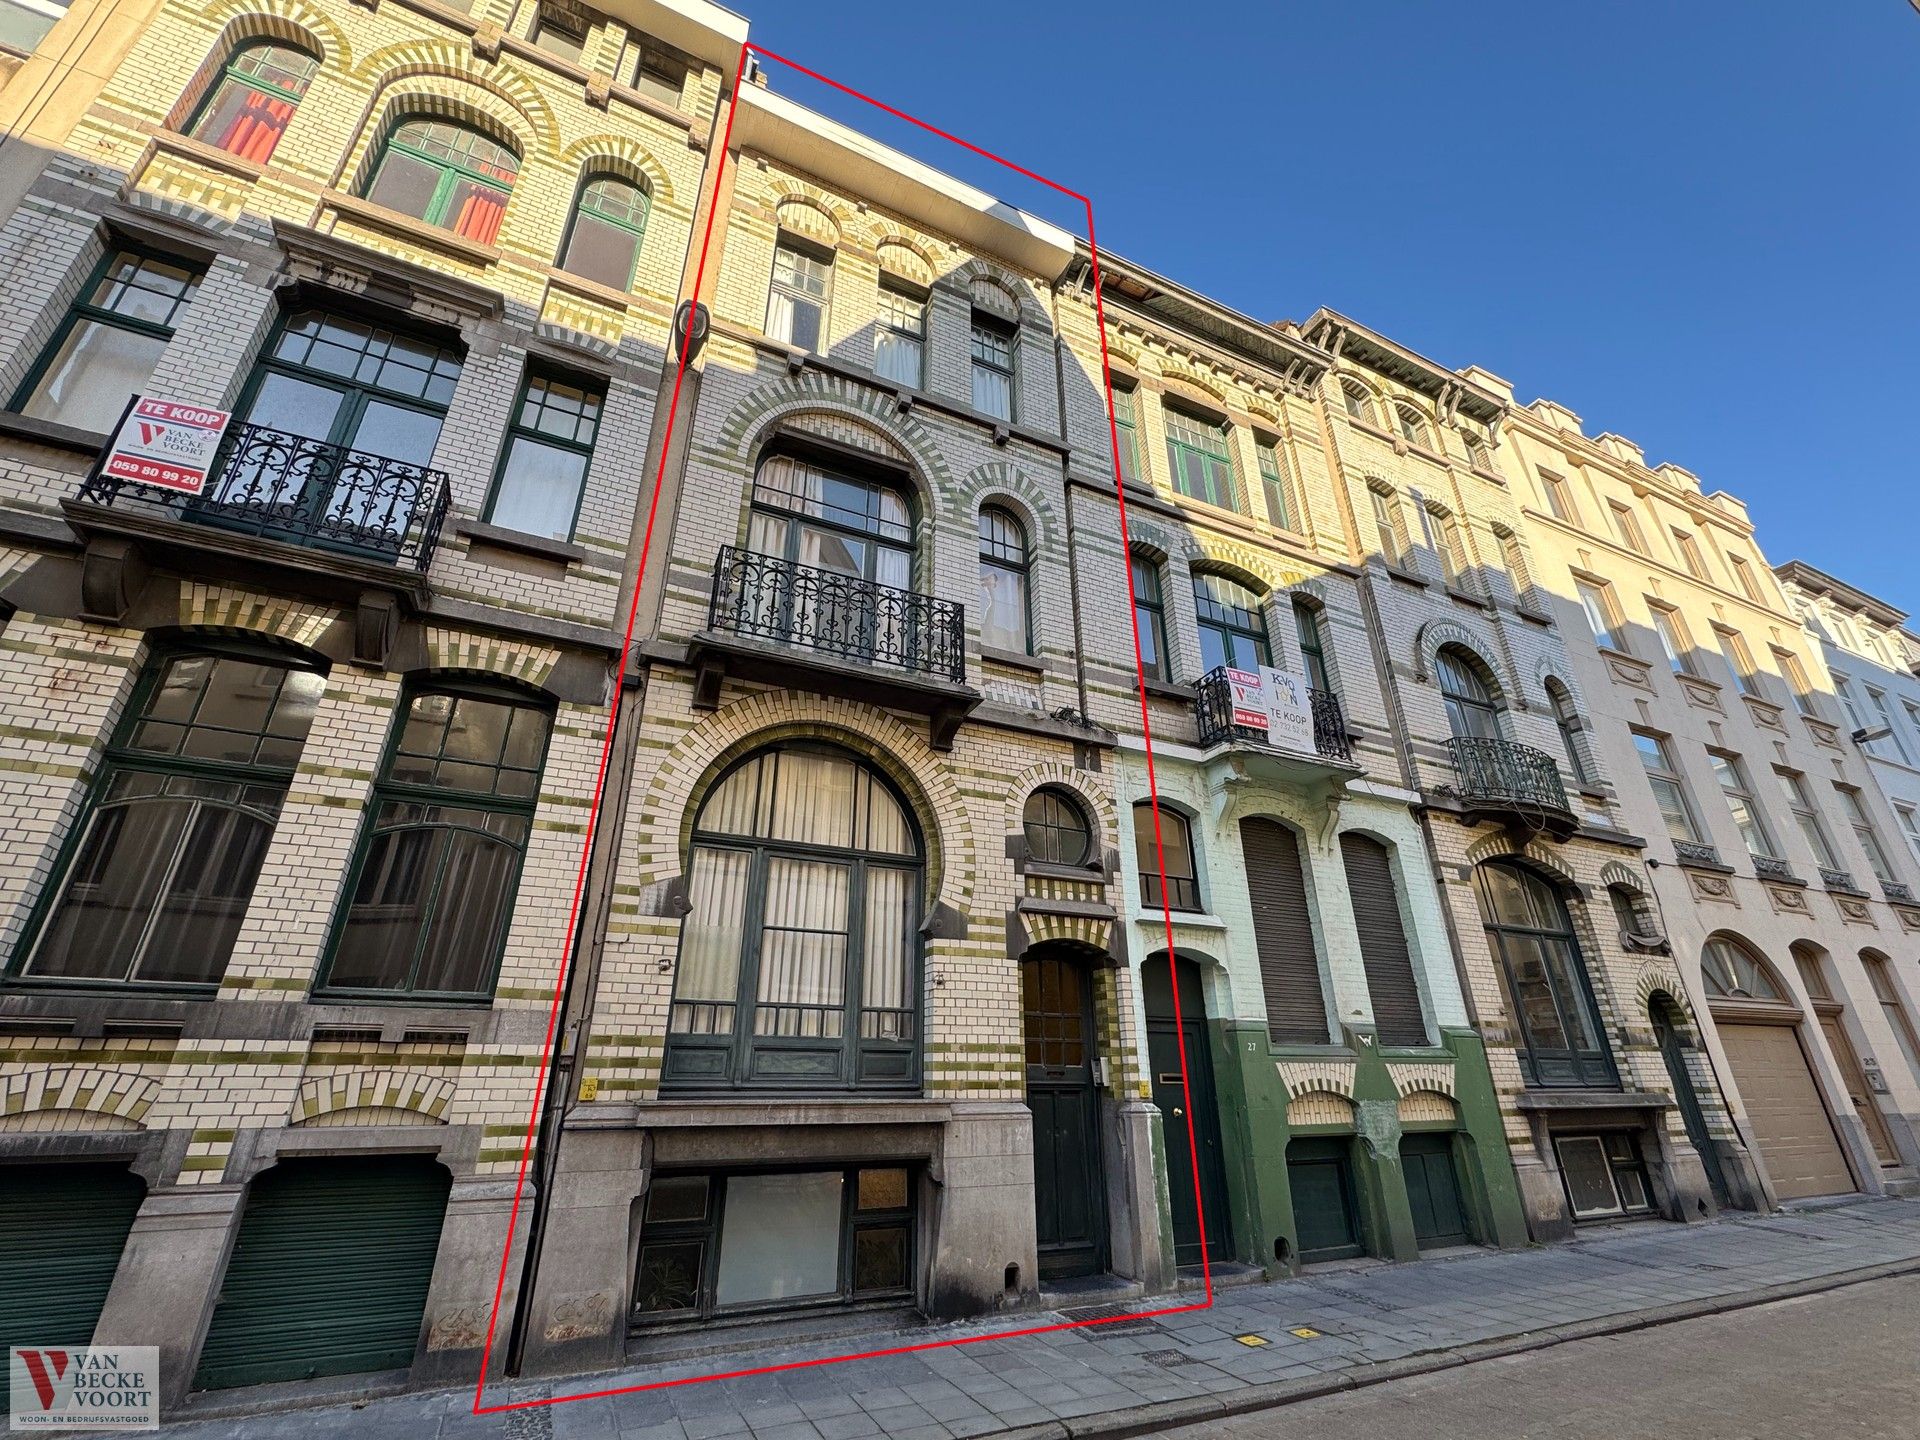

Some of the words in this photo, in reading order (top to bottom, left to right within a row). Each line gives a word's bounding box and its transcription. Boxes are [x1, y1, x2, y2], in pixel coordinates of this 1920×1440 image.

[144, 403, 167, 415] TE
[170, 407, 220, 425] KOOP
[168, 429, 193, 440] VAN
[162, 442, 206, 456] VOORT
[164, 435, 202, 449] BECKE
[113, 460, 139, 473] 059
[141, 466, 159, 477] 80
[161, 471, 179, 481] 99
[181, 475, 199, 485] 20
[1230, 671, 1239, 680] TE
[1240, 673, 1258, 685] KOOP
[1270, 707, 1281, 719] TE
[1283, 711, 1307, 725] KOOP
[1247, 1042, 1256, 1051] 27
